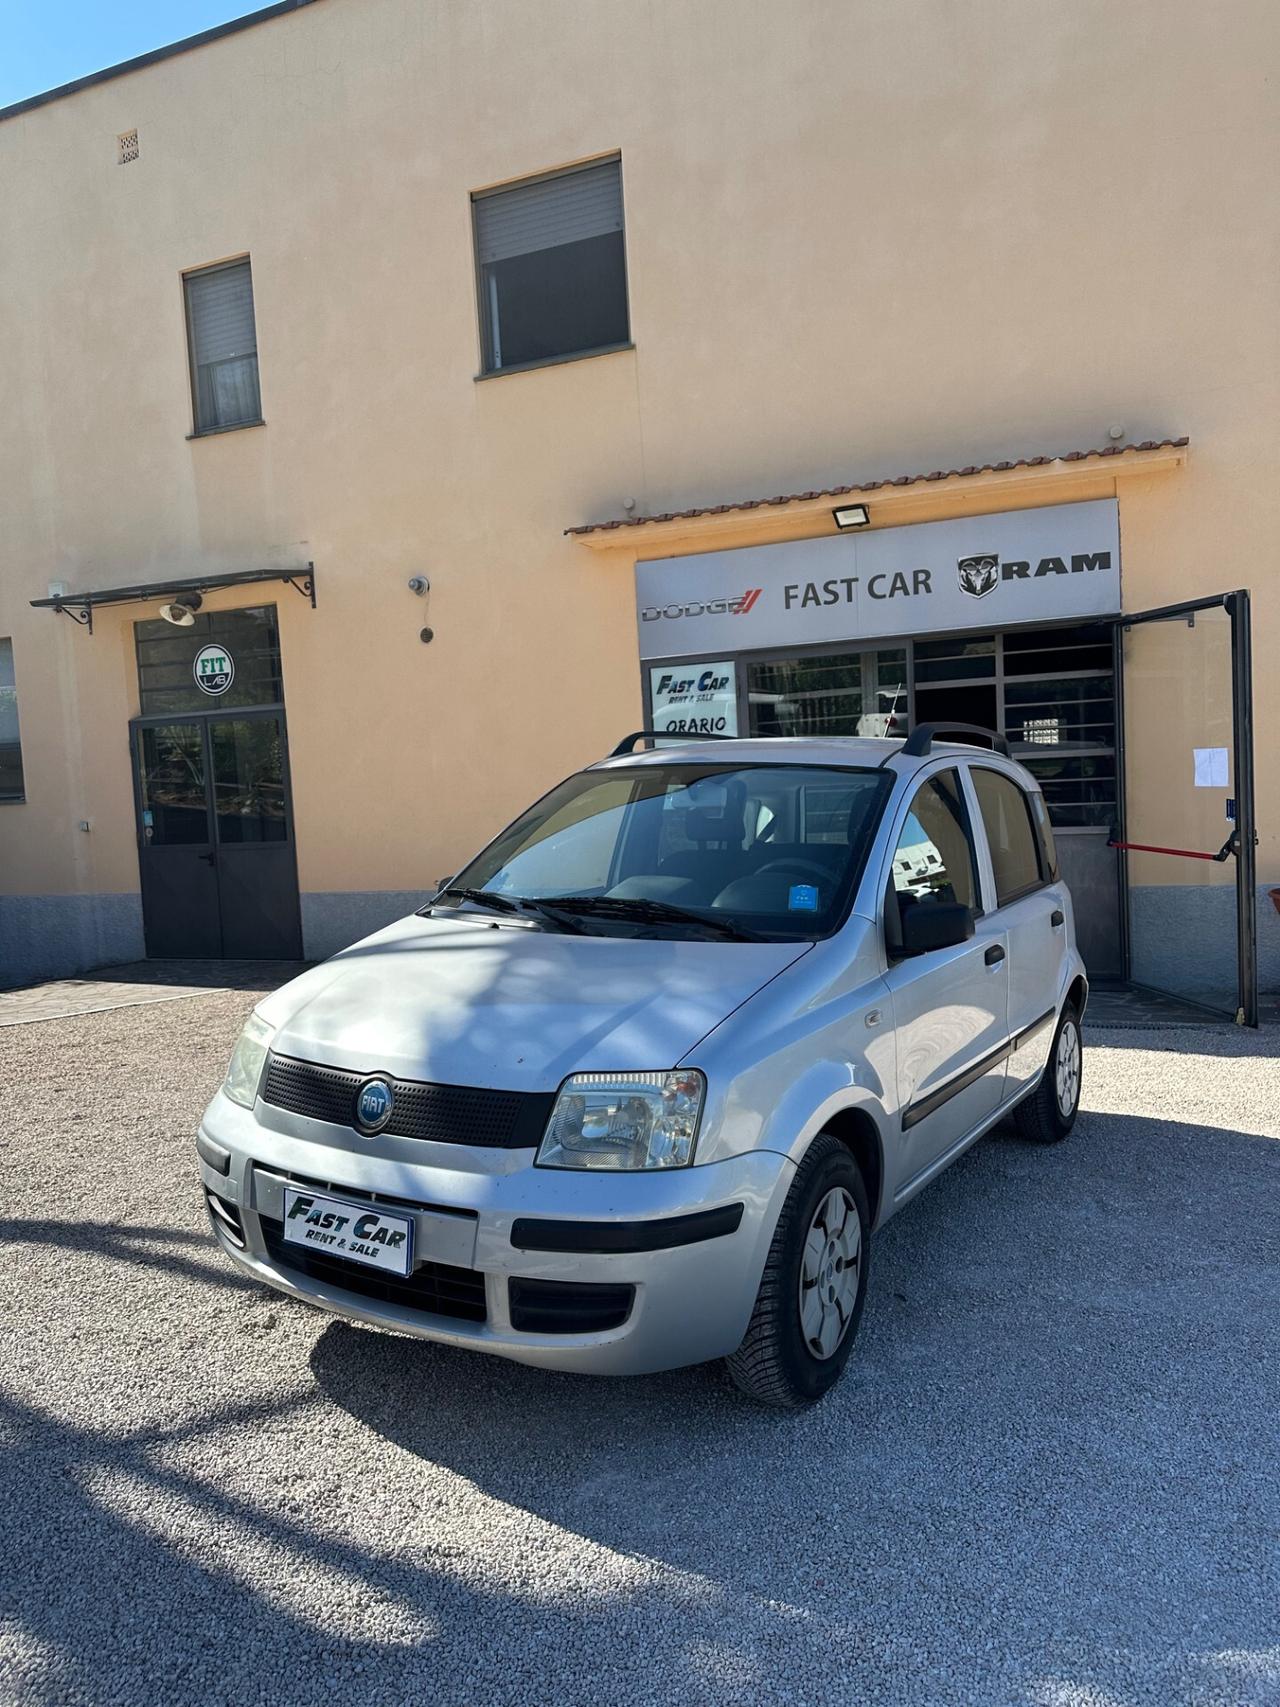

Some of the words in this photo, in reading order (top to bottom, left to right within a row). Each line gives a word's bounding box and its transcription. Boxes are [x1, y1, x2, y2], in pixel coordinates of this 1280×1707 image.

[1001, 551, 1111, 581] RAM
[784, 577, 859, 610] FAST
[867, 569, 933, 599] CAR
[641, 596, 746, 622] DODGE
[200, 656, 226, 674] FIT
[203, 675, 226, 686] LAB
[656, 675, 695, 695] FAST
[698, 671, 729, 692] CAR
[669, 695, 688, 704] RENT
[696, 693, 715, 703] SALE
[666, 717, 726, 734] ORARIO
[361, 1095, 385, 1114] FIAT
[287, 1196, 350, 1233] FAST
[353, 1214, 407, 1249] CAR
[305, 1229, 337, 1245] RENT
[337, 1238, 347, 1249] &
[348, 1241, 380, 1258] SALE
